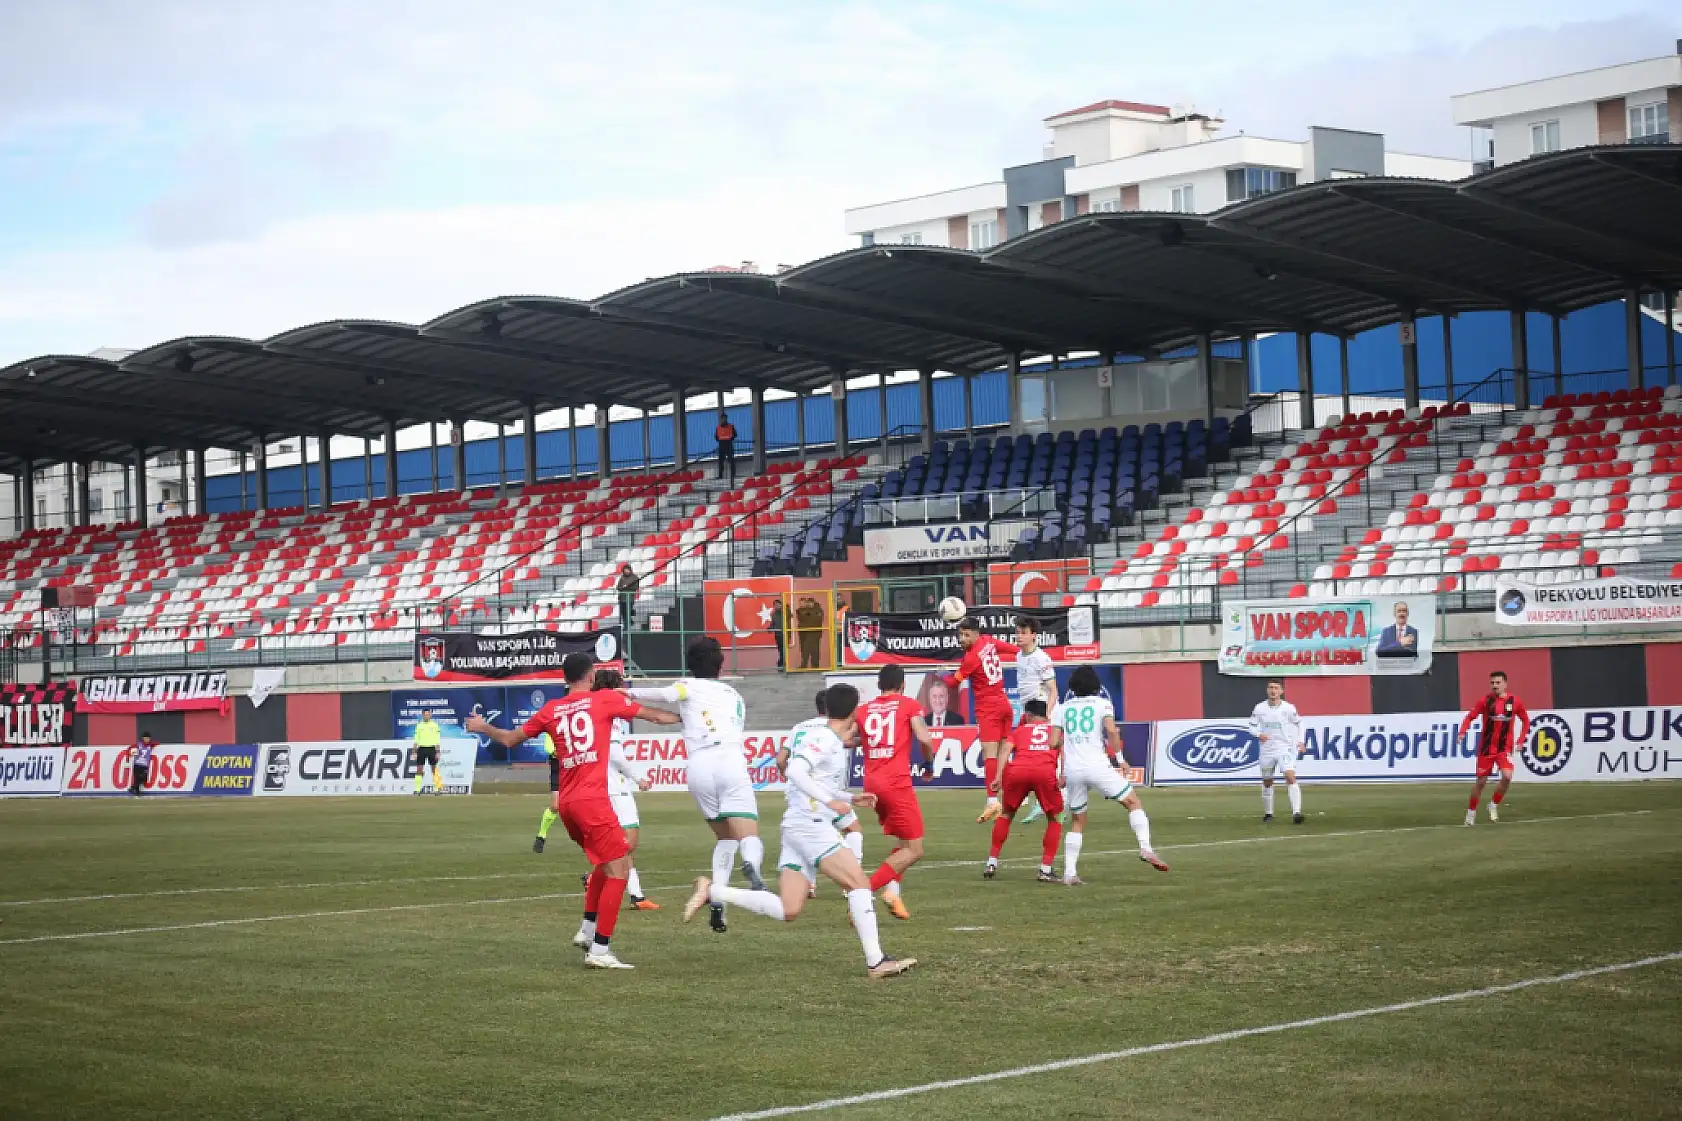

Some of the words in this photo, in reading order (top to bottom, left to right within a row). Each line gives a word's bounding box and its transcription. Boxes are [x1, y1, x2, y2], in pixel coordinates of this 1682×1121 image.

[924, 525, 990, 543] VAN
[930, 548, 939, 558] VE
[941, 546, 961, 557] SPOR
[1534, 586, 1606, 602] İPEKYOLU
[1527, 610, 1544, 622] VAN
[1597, 607, 1634, 620] YOLUNDA
[1635, 604, 1681, 623] BAŞARILAR
[918, 617, 944, 631] VAN
[1250, 612, 1291, 641] VAN
[477, 639, 496, 652] VAN
[886, 636, 941, 650] YOLUNDA
[450, 656, 494, 669] YOLUNDA
[494, 654, 547, 670] BAŞARILAR
[865, 710, 897, 747] 91
[1064, 706, 1095, 735] 88
[555, 711, 595, 754] 19
[1030, 726, 1049, 745] 5
[1185, 731, 1252, 765] Ford
[1297, 723, 1480, 769] Akköprülü
[67, 750, 101, 789] 2A
[112, 749, 189, 789] GOSS
[205, 755, 253, 769] TOPTAN
[298, 748, 418, 780] CEMRE
[202, 775, 253, 789] MARKET
